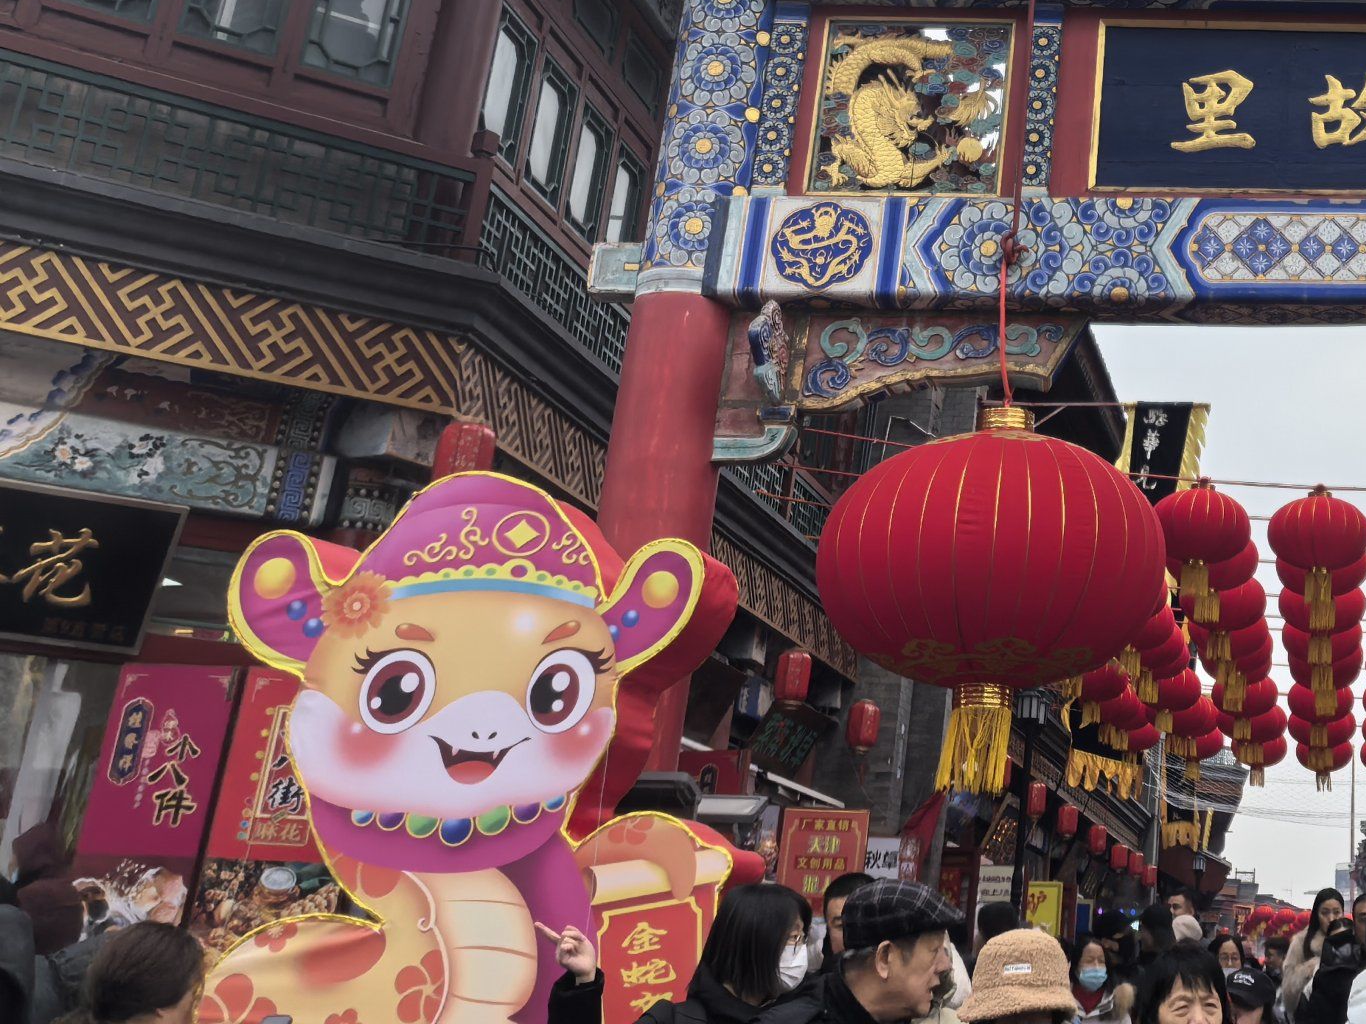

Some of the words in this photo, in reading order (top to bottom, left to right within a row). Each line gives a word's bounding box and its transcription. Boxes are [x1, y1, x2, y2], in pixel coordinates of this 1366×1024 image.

[0, 526, 100, 607] 花
[147, 733, 201, 828] 小八件
[253, 822, 302, 842] 麻花
[801, 818, 850, 832] 厂家直销
